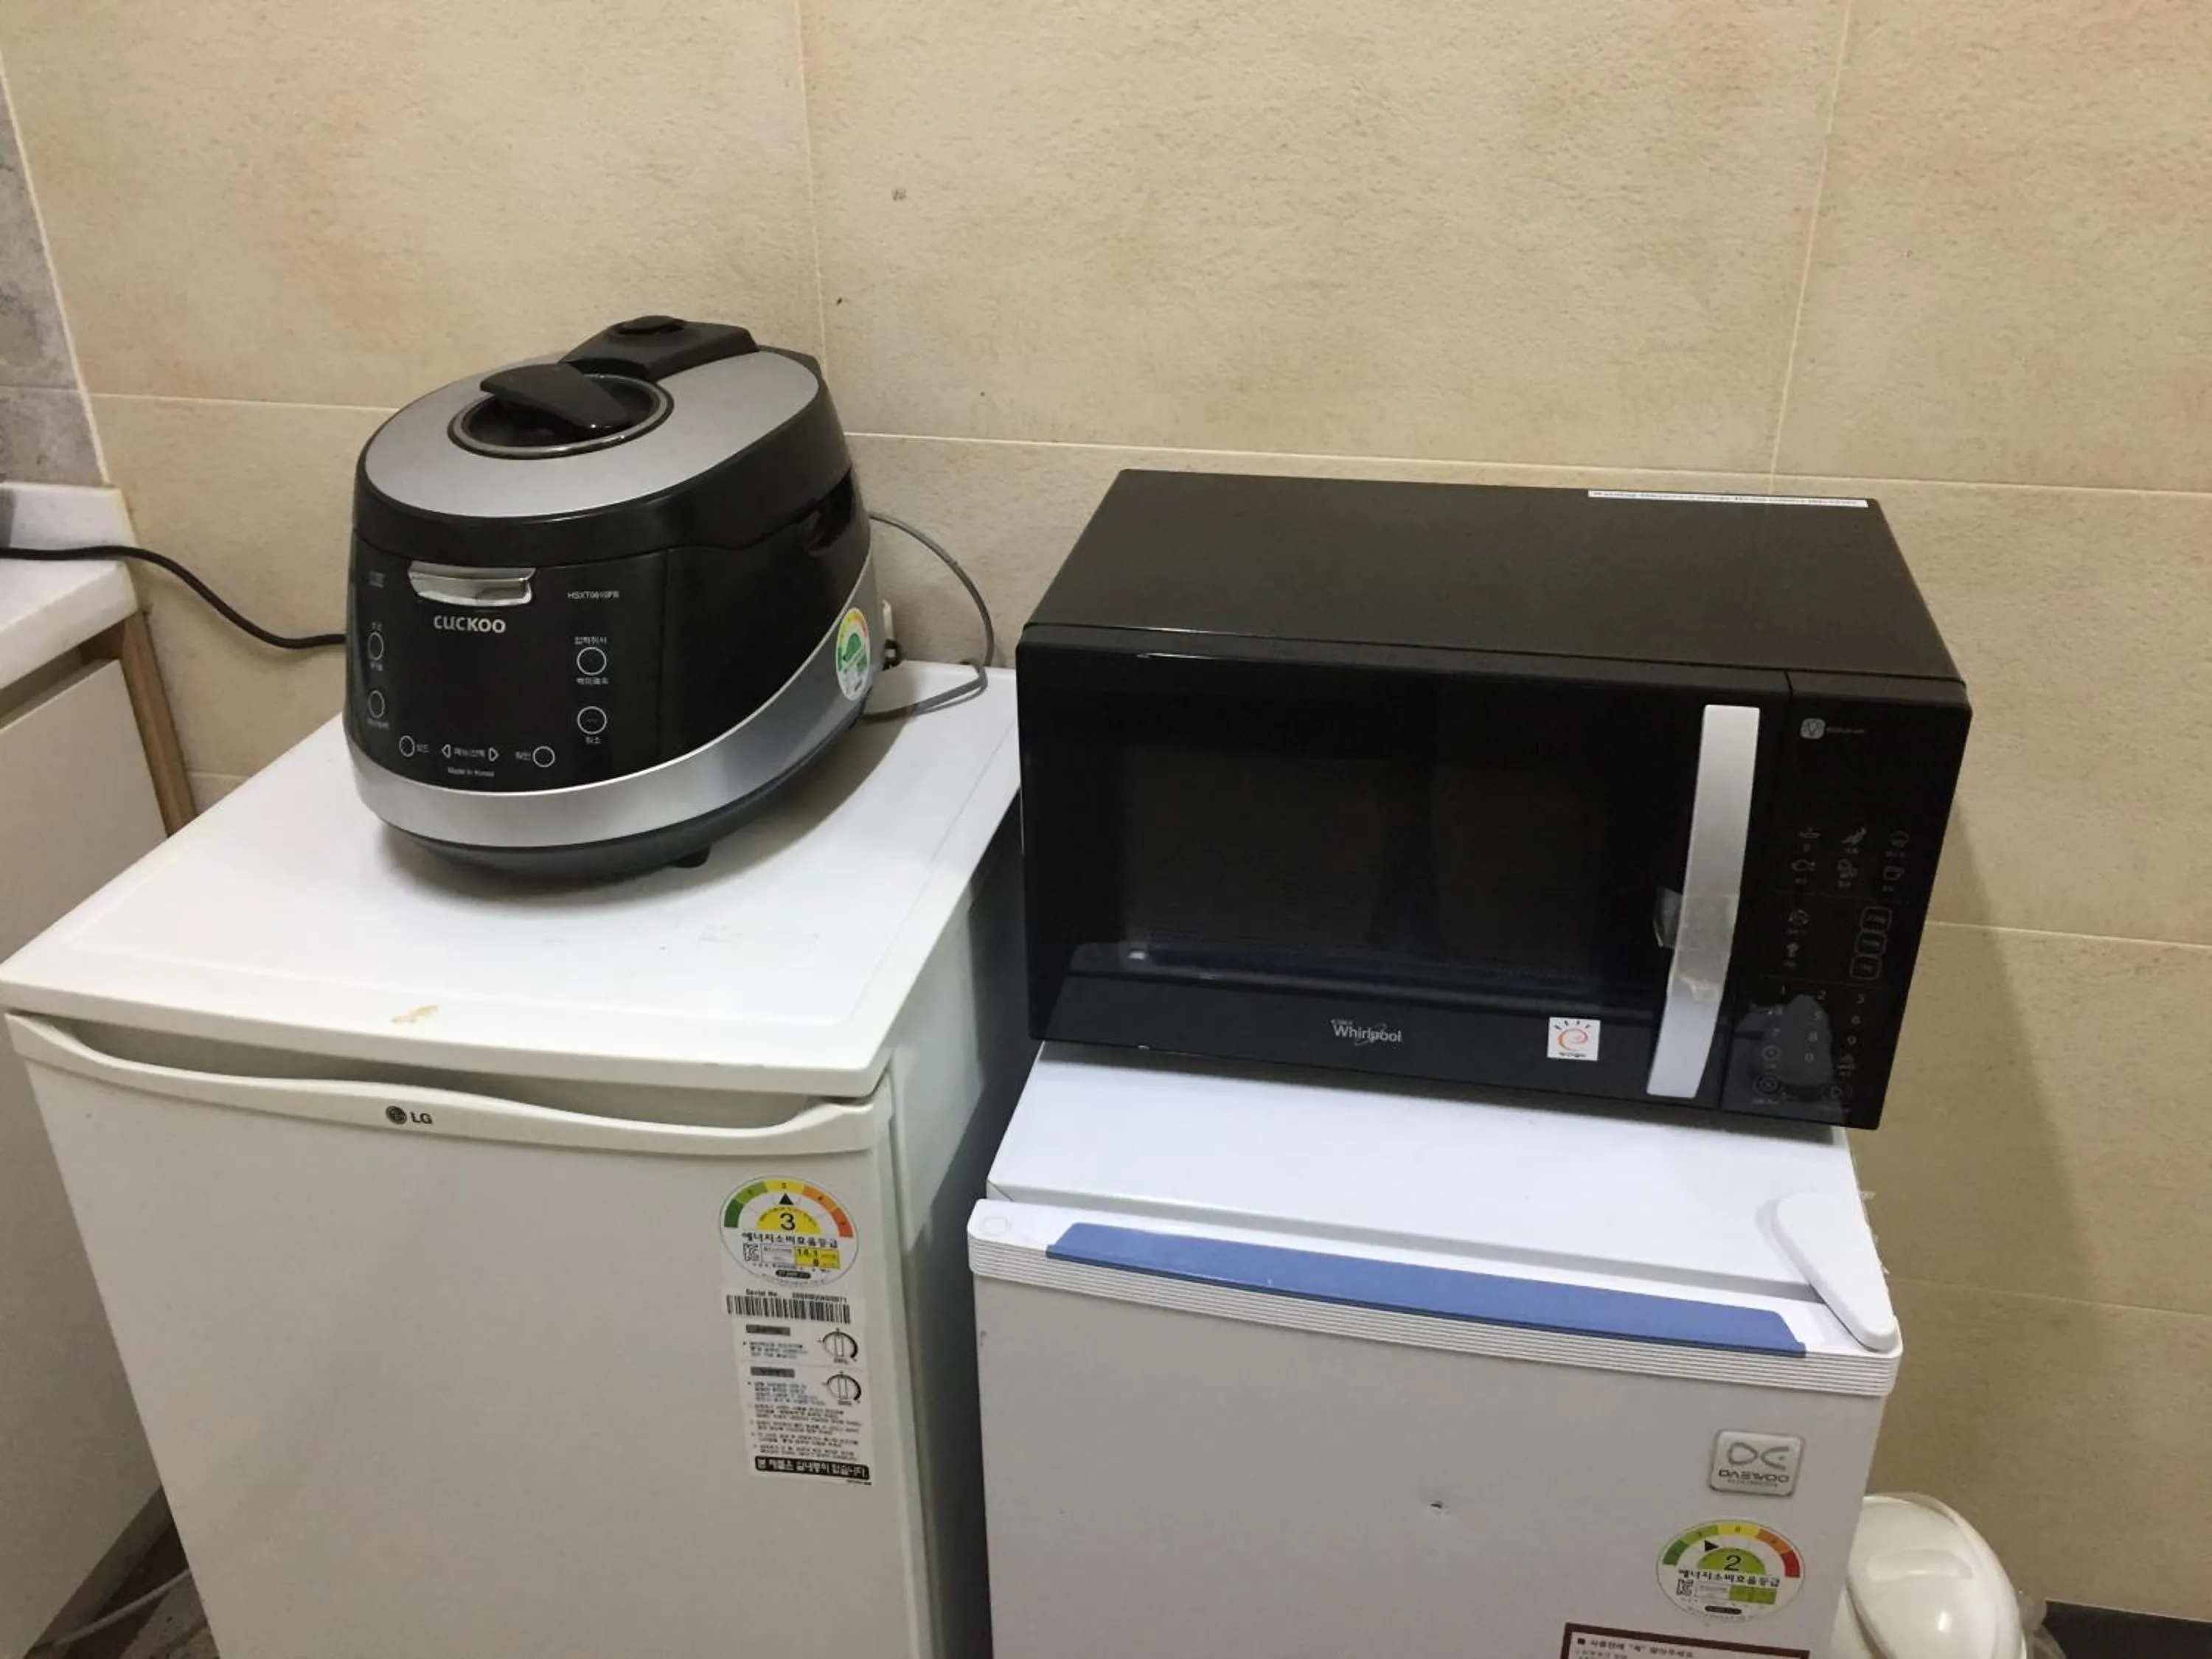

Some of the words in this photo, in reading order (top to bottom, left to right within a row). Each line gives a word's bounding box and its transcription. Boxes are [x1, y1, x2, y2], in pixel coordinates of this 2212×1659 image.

[434, 614, 506, 633] CUCKOO
[1817, 990, 1827, 1001] 2
[1333, 1024, 1402, 1044] Whirlpool
[410, 1111, 434, 1124] LG
[779, 1212, 796, 1231] 3
[742, 1232, 838, 1249] 에너지소비효율등급
[746, 1289, 765, 1297] Serial
[1719, 1469, 1790, 1483] DAEWOO
[1724, 1554, 1742, 1571] 2
[1678, 1569, 1781, 1587] 에너지소비효율등급
